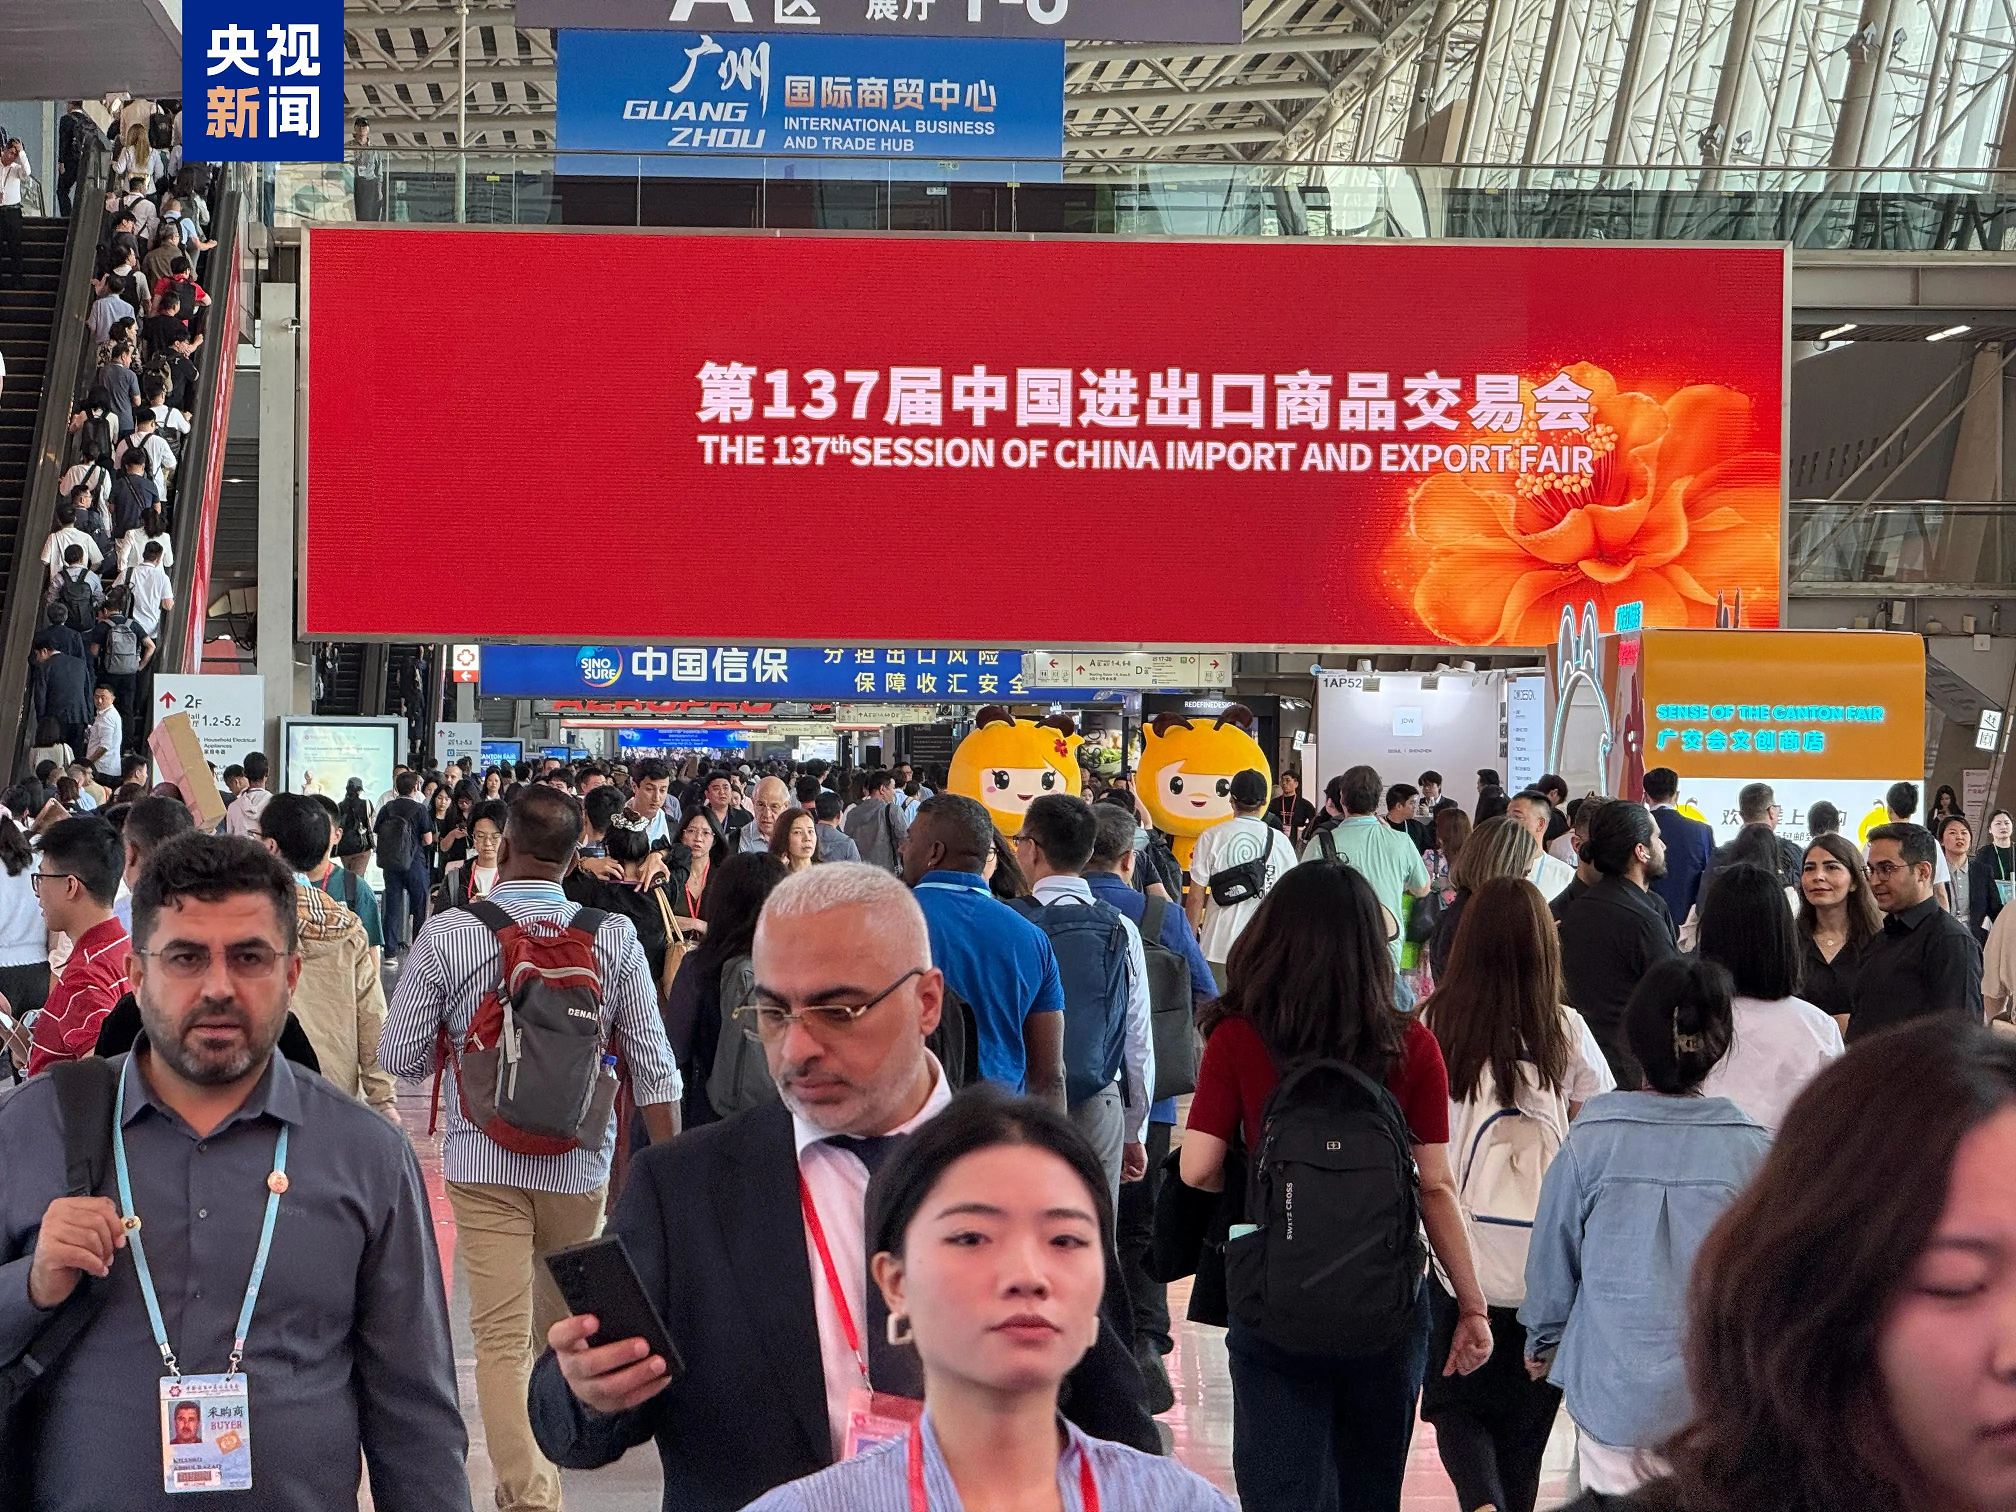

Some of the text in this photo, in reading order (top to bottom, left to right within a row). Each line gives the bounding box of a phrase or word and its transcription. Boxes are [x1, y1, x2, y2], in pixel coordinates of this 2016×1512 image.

[668, 34, 771, 118] 广州
[784, 75, 997, 113] 国际商贸中心
[623, 100, 749, 122] GUANG
[784, 116, 995, 135] INTERNATIONAL BUSINESS
[667, 127, 766, 149] ZHOU
[784, 135, 914, 152] AND TRADE HUB
[696, 361, 1594, 432] 第137届中国进出口商品交易会
[698, 434, 765, 465] THE
[1002, 438, 1047, 468] OF
[1054, 439, 1159, 470] CHINA
[1167, 441, 1296, 471] IMPORT
[1302, 443, 1371, 472] AND
[1381, 443, 1512, 473] EXPORT
[1520, 445, 1594, 474] FAIR
[581, 658, 611, 670] SINO
[632, 647, 788, 683] 中国信保
[824, 649, 999, 665] 分担出口风险
[585, 669, 617, 679] SURE
[855, 672, 1030, 694] 保障收汇安全
[1323, 678, 1362, 688] 1AP52
[184, 694, 202, 708] 2F
[202, 714, 241, 727] 1.2-5.2
[1656, 704, 1884, 722] SENSE OF THE CANTON FAIR
[1656, 729, 1826, 752] 广交会文创商店
[210, 1421, 242, 1430] BUYER
